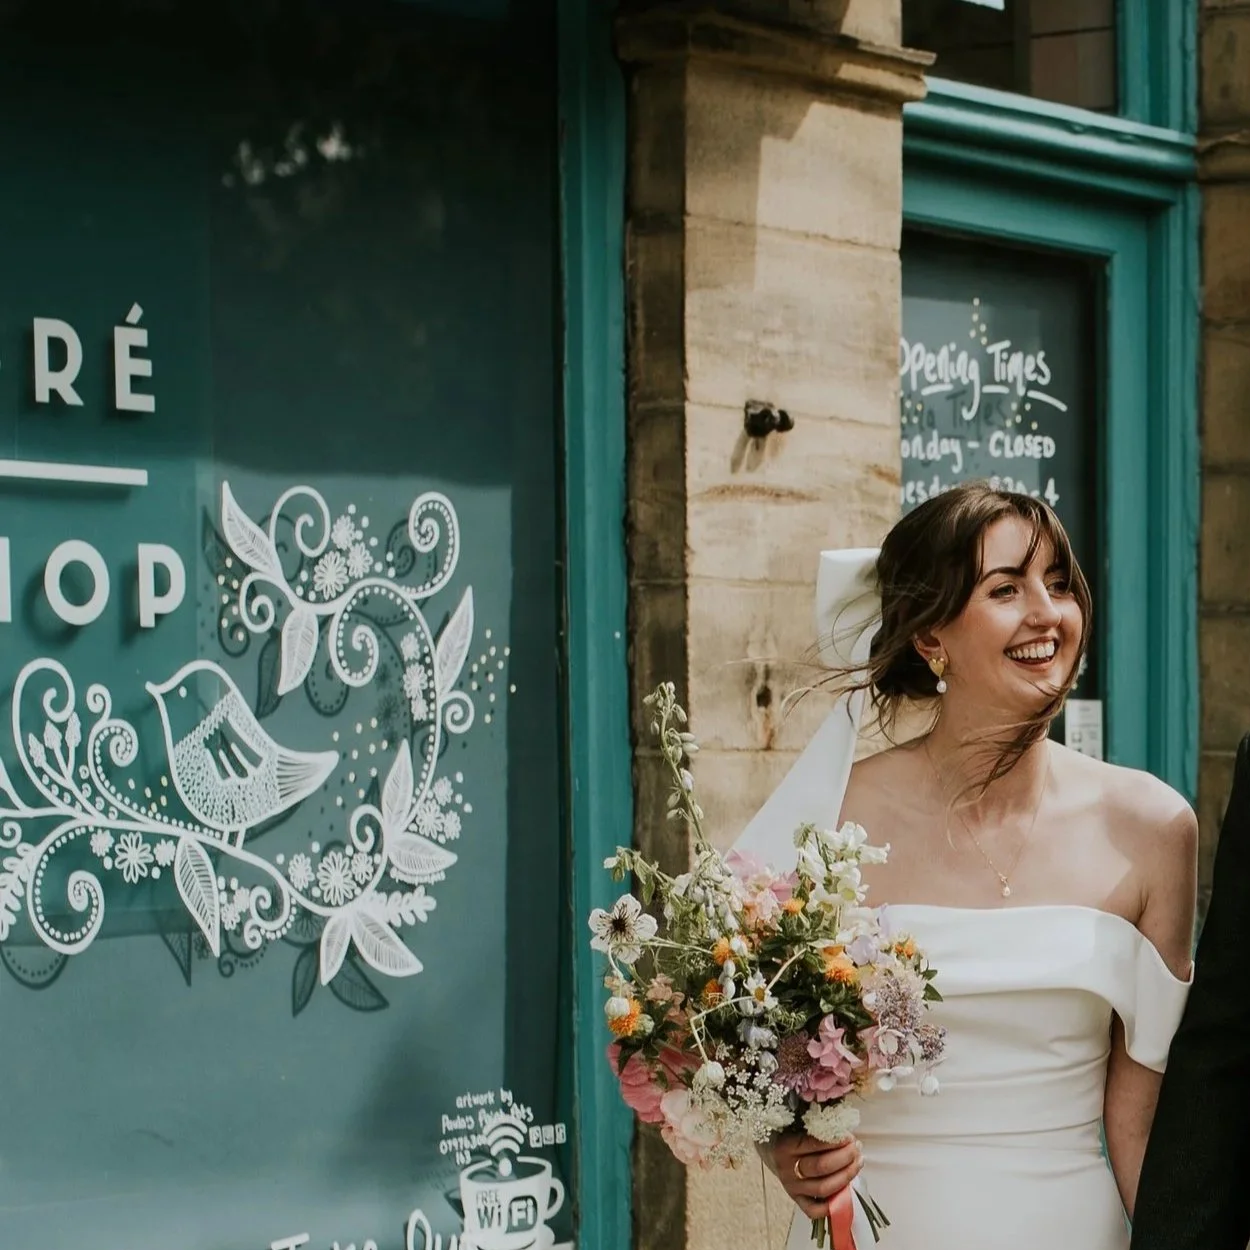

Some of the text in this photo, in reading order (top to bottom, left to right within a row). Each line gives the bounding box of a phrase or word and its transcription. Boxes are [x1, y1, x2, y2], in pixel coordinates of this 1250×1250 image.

[0, 302, 155, 412] RÉ
[986, 340, 1051, 396] Times
[901, 429, 963, 474] onday
[989, 430, 1056, 459] CLOSED
[455, 1087, 513, 1109] artwork by
[476, 1189, 500, 1206] FREE
